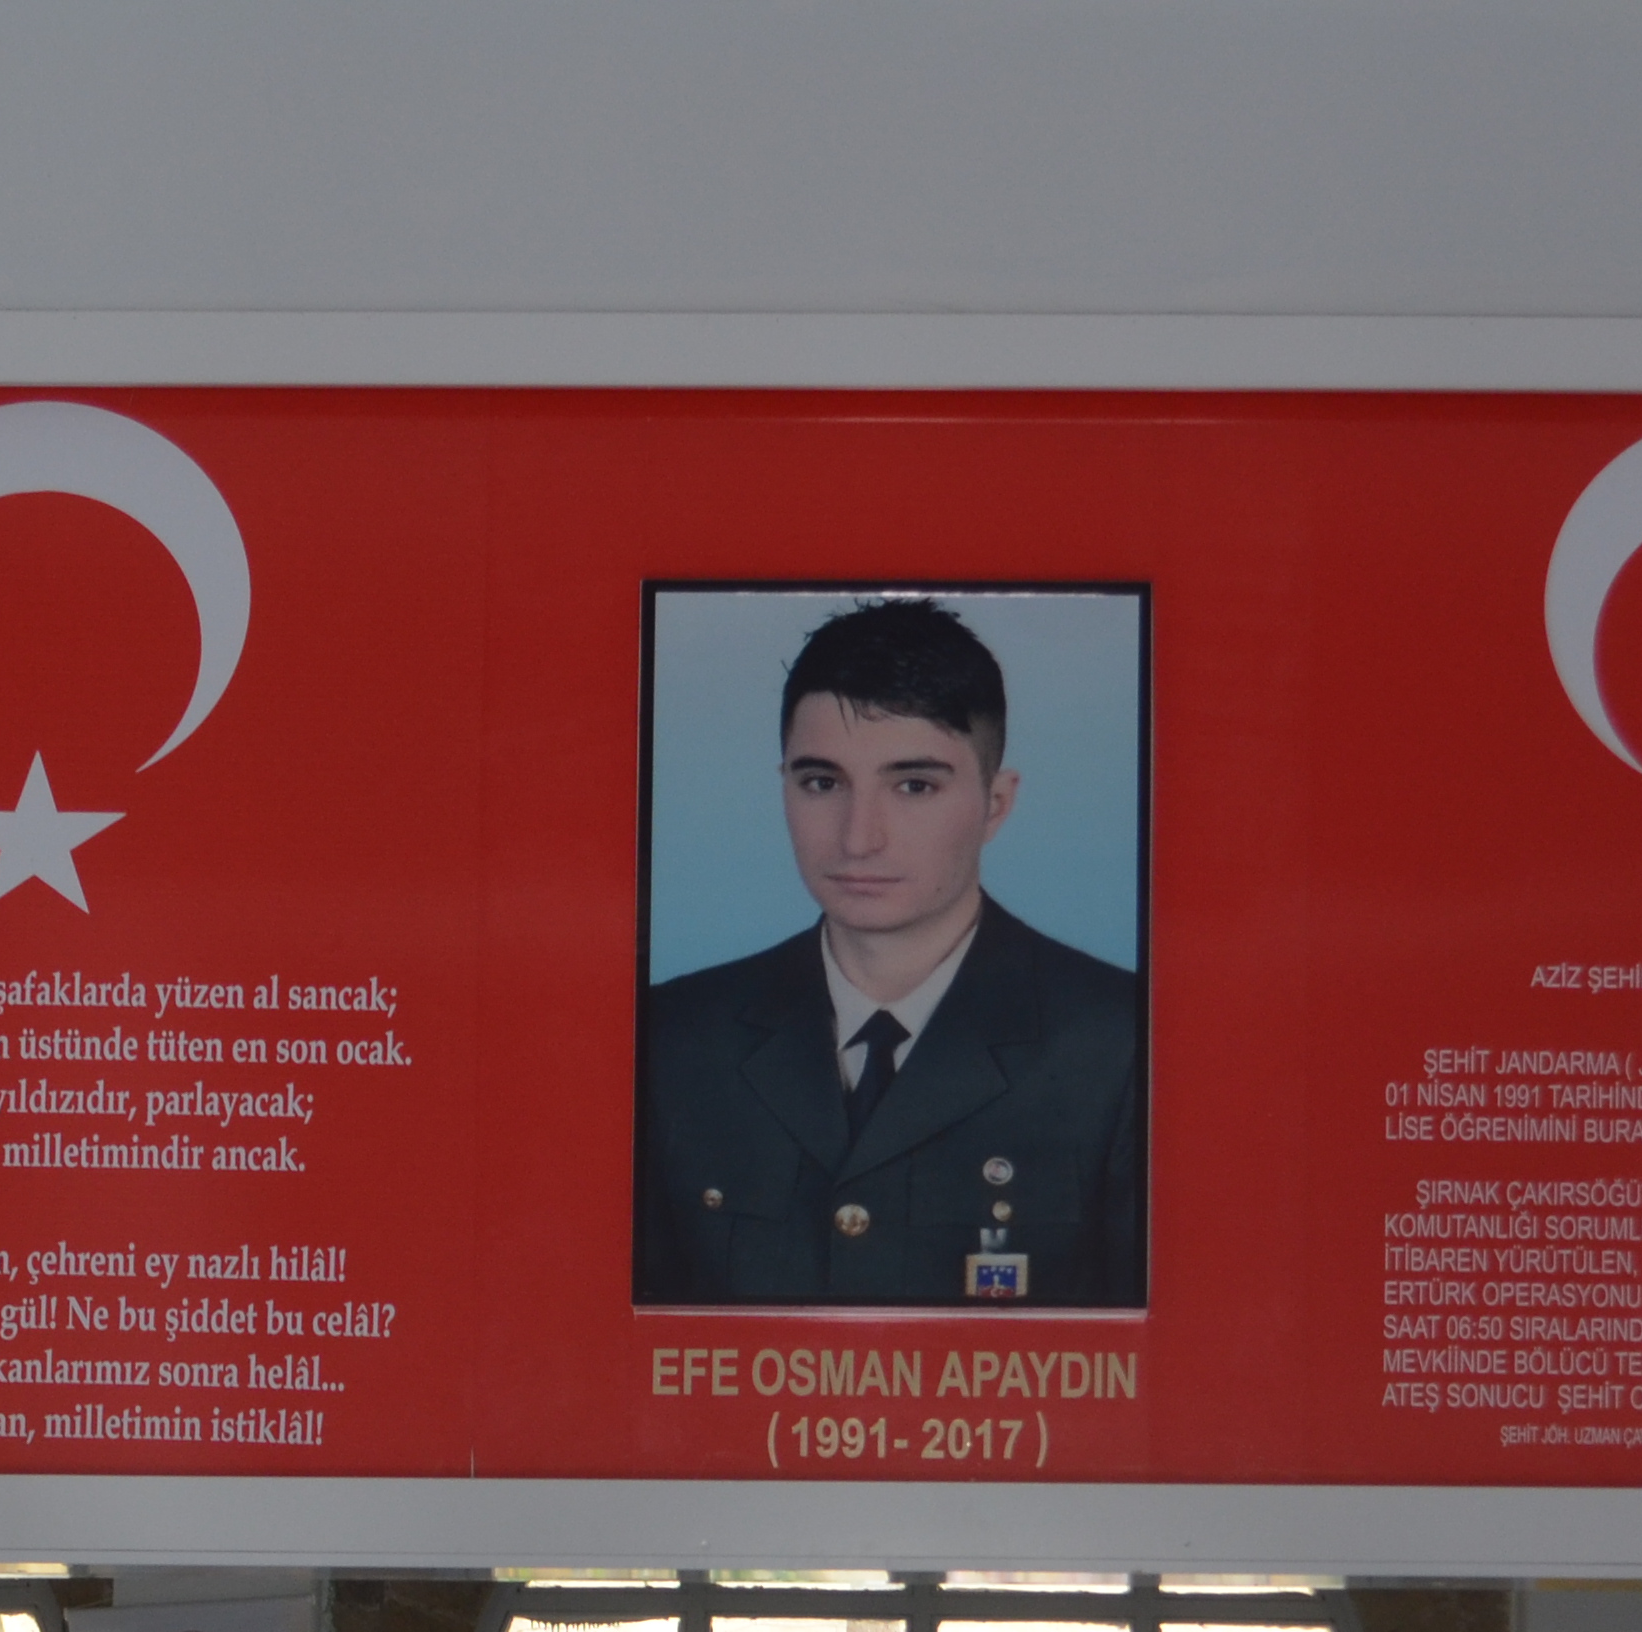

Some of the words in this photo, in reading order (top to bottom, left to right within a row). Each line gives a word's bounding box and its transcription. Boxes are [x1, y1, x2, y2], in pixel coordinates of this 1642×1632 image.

[1531, 962, 1584, 991] AZİZ
[155, 976, 246, 1021] yüzen
[253, 974, 281, 1011] al
[289, 976, 398, 1020] sancak;
[19, 1026, 140, 1063] üstünde
[147, 1030, 225, 1064] tüten
[233, 1039, 269, 1065] en
[277, 1039, 329, 1066] son
[337, 1030, 413, 1067] ocak.
[145, 1080, 315, 1130] parlayacak;
[1386, 1082, 1410, 1108] 01
[1418, 1079, 1488, 1110] NİSAN
[1494, 1083, 1542, 1111] 1991
[1386, 1112, 1435, 1143] LİSE
[1441, 1112, 1579, 1144] ÖĞRENİMİNİ
[3, 1132, 206, 1172] milletimindir
[212, 1136, 307, 1173] ancak.
[1416, 1179, 1502, 1212] ŞIRNAK
[1385, 1211, 1540, 1242] KOMUTANLIĞI
[27, 1241, 138, 1287] çehreni
[145, 1253, 181, 1291] ey
[188, 1244, 262, 1281] nazlı
[270, 1246, 347, 1285] hilâl!
[1385, 1278, 1478, 1308] ERTÜRK
[0, 1294, 59, 1343] gül!
[66, 1295, 111, 1333] Ne
[118, 1295, 158, 1334] bu
[165, 1297, 259, 1344] şiddet
[266, 1299, 305, 1338] bu
[313, 1302, 397, 1340] celâl?
[1384, 1314, 1443, 1341] SAAT
[1447, 1315, 1505, 1342] 06:50
[159, 1361, 241, 1390] sonra
[652, 1349, 739, 1396] EFE
[751, 1349, 922, 1397] OSMAN
[936, 1351, 1137, 1399] APAYDIN
[44, 1403, 203, 1443] milletimin
[211, 1406, 325, 1447] istiklâl!
